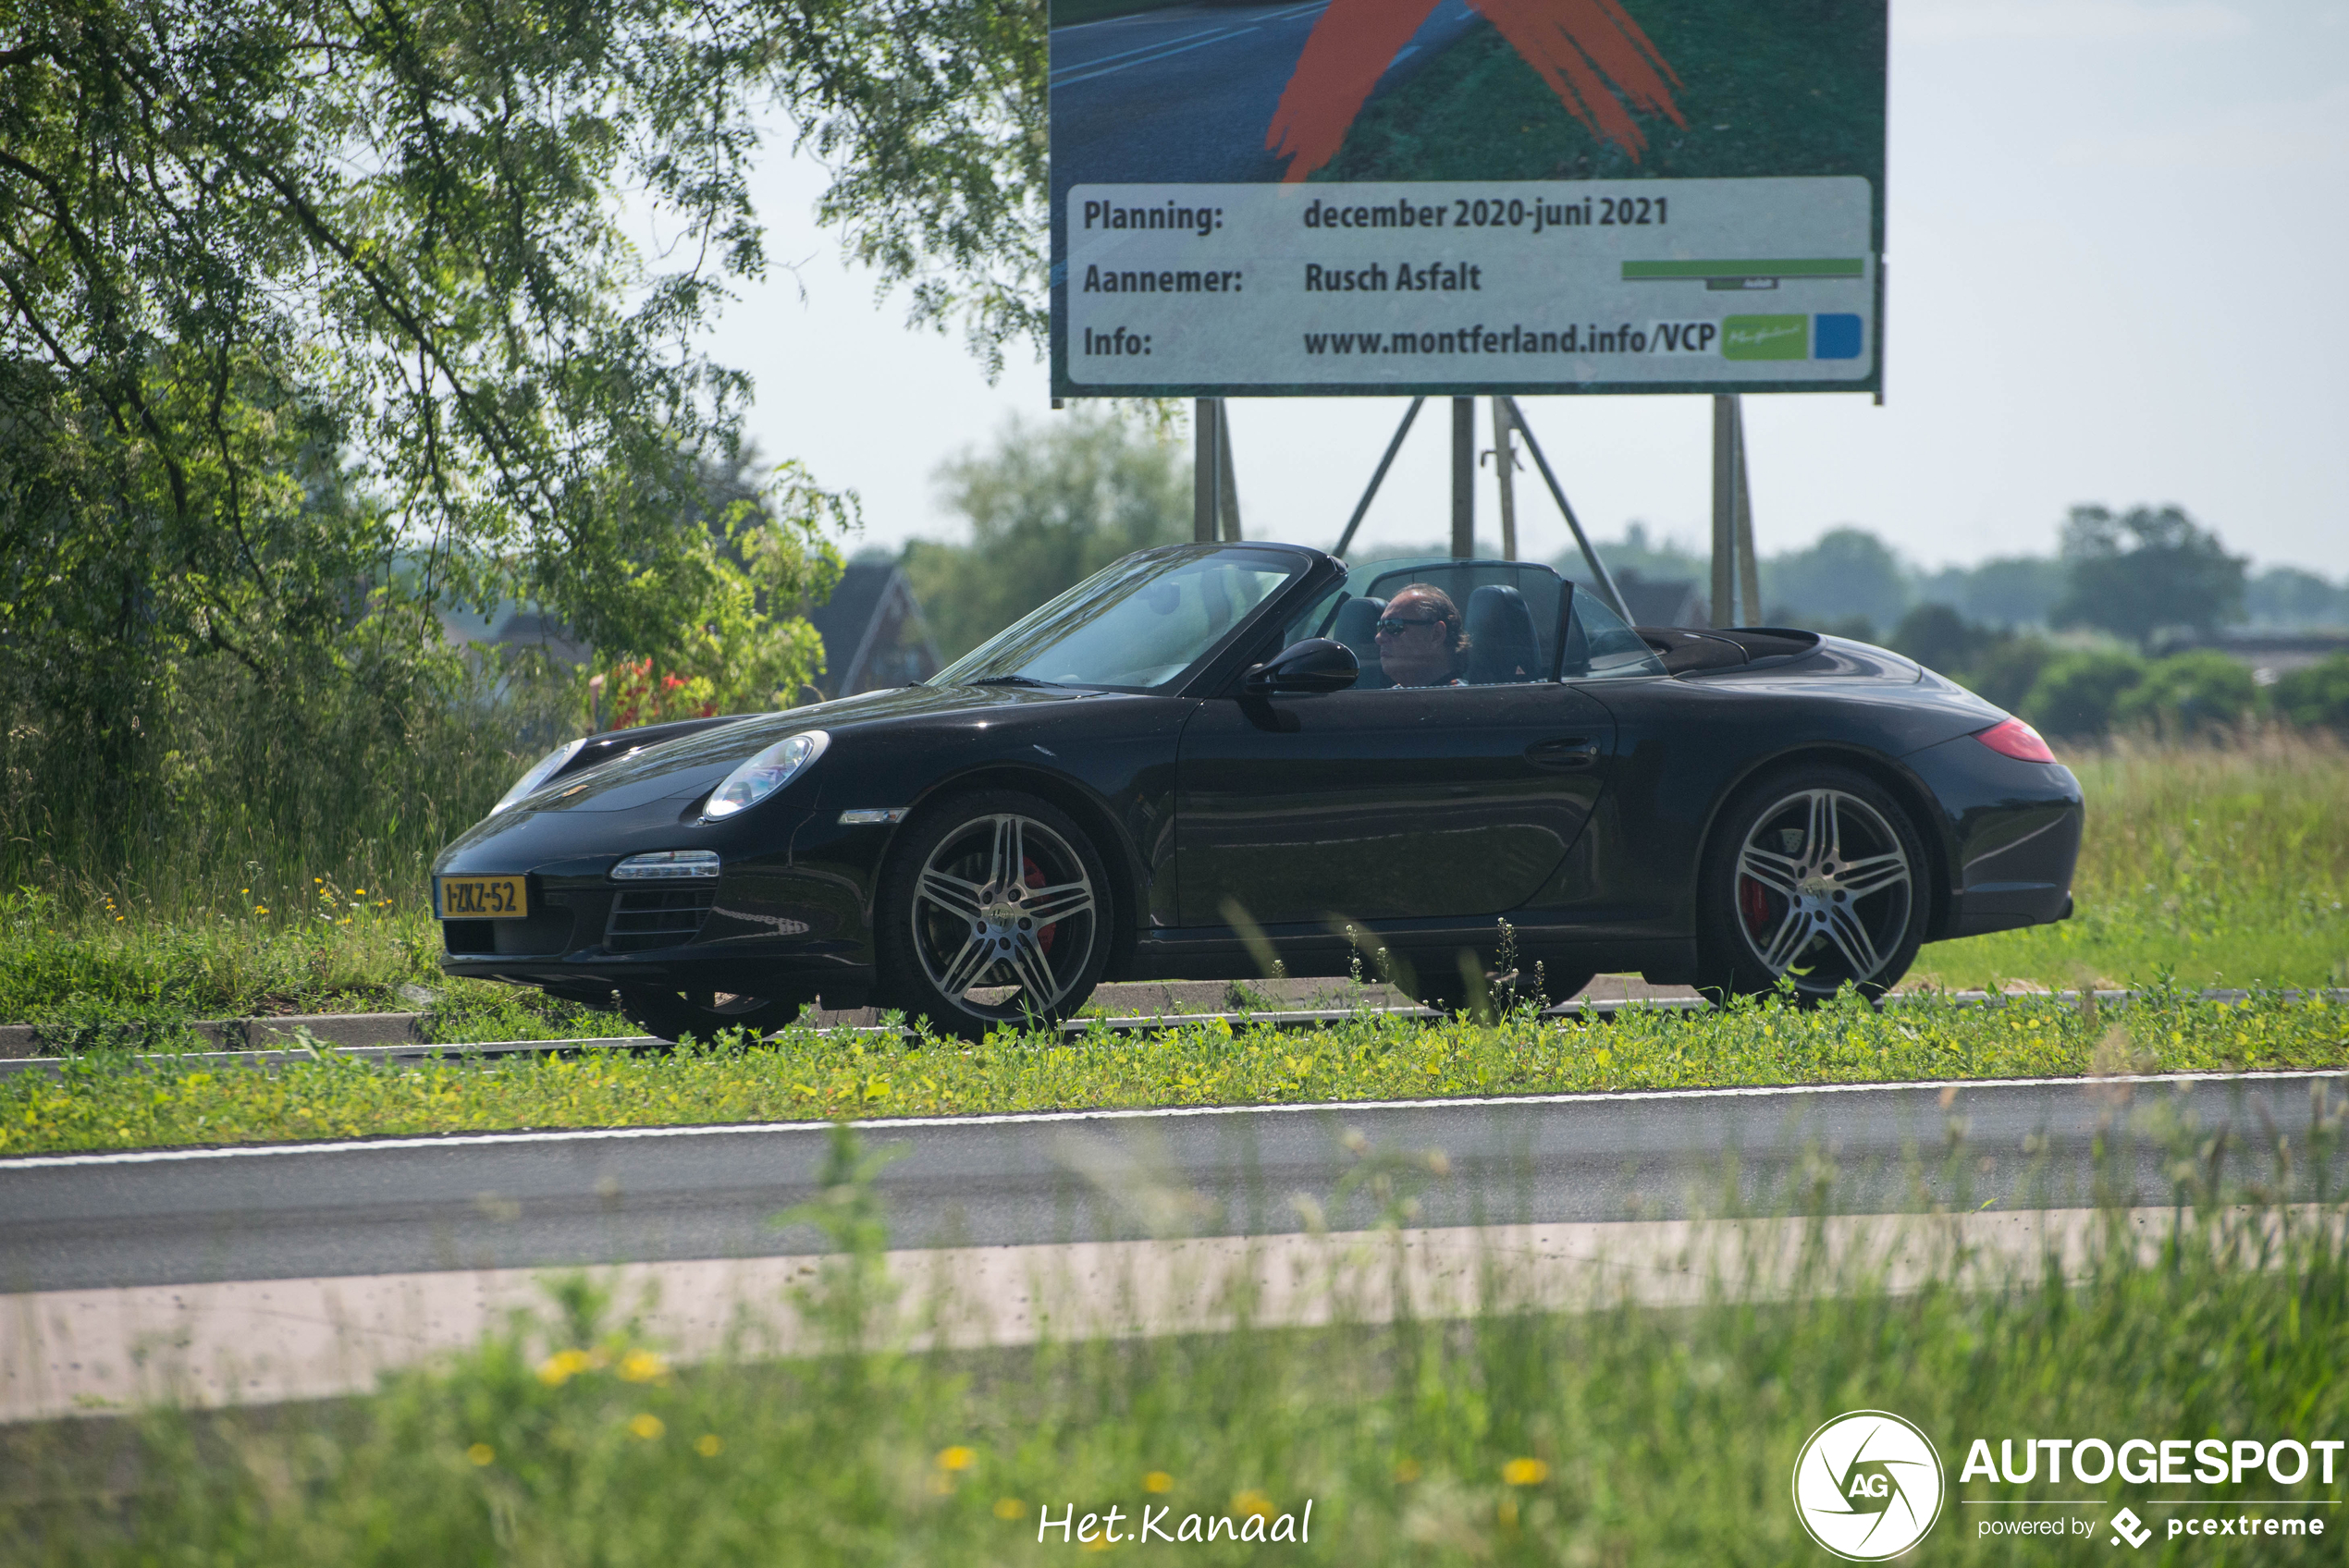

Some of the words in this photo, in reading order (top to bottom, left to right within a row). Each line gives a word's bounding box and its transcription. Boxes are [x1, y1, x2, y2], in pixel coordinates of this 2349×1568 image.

[1084, 199, 1224, 237] Planning:
[1303, 197, 1448, 228] december
[1454, 196, 1593, 234] 2020-juni
[1599, 197, 1668, 226] 2021
[1083, 264, 1243, 293] Aannemer:
[1305, 262, 1388, 291] Rusch
[1395, 262, 1482, 291] Asfalt
[1084, 326, 1152, 355] Info:
[1303, 322, 1717, 355] www.montferland.info/VCP
[446, 881, 516, 913] 1-ZKZ-52
